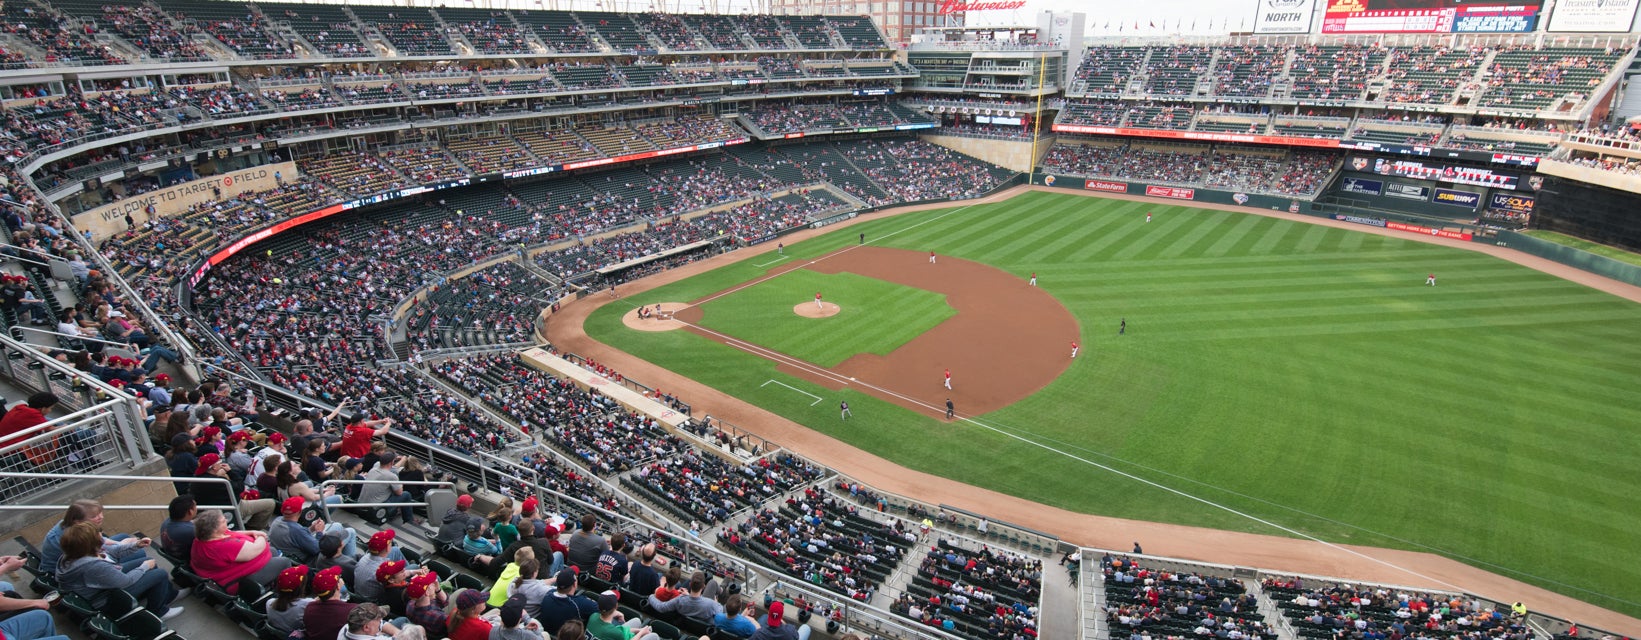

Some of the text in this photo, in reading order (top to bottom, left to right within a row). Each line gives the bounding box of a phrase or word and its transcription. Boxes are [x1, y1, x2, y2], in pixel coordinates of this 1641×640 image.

[936, 0, 1026, 14] Budweiser
[1265, 13, 1302, 21] NORTH
[101, 169, 267, 221] WELCOME TO TARGET FIELD
[1437, 193, 1476, 202] SUBWAY
[599, 554, 618, 566] BUXTON
[596, 562, 613, 581] 25
